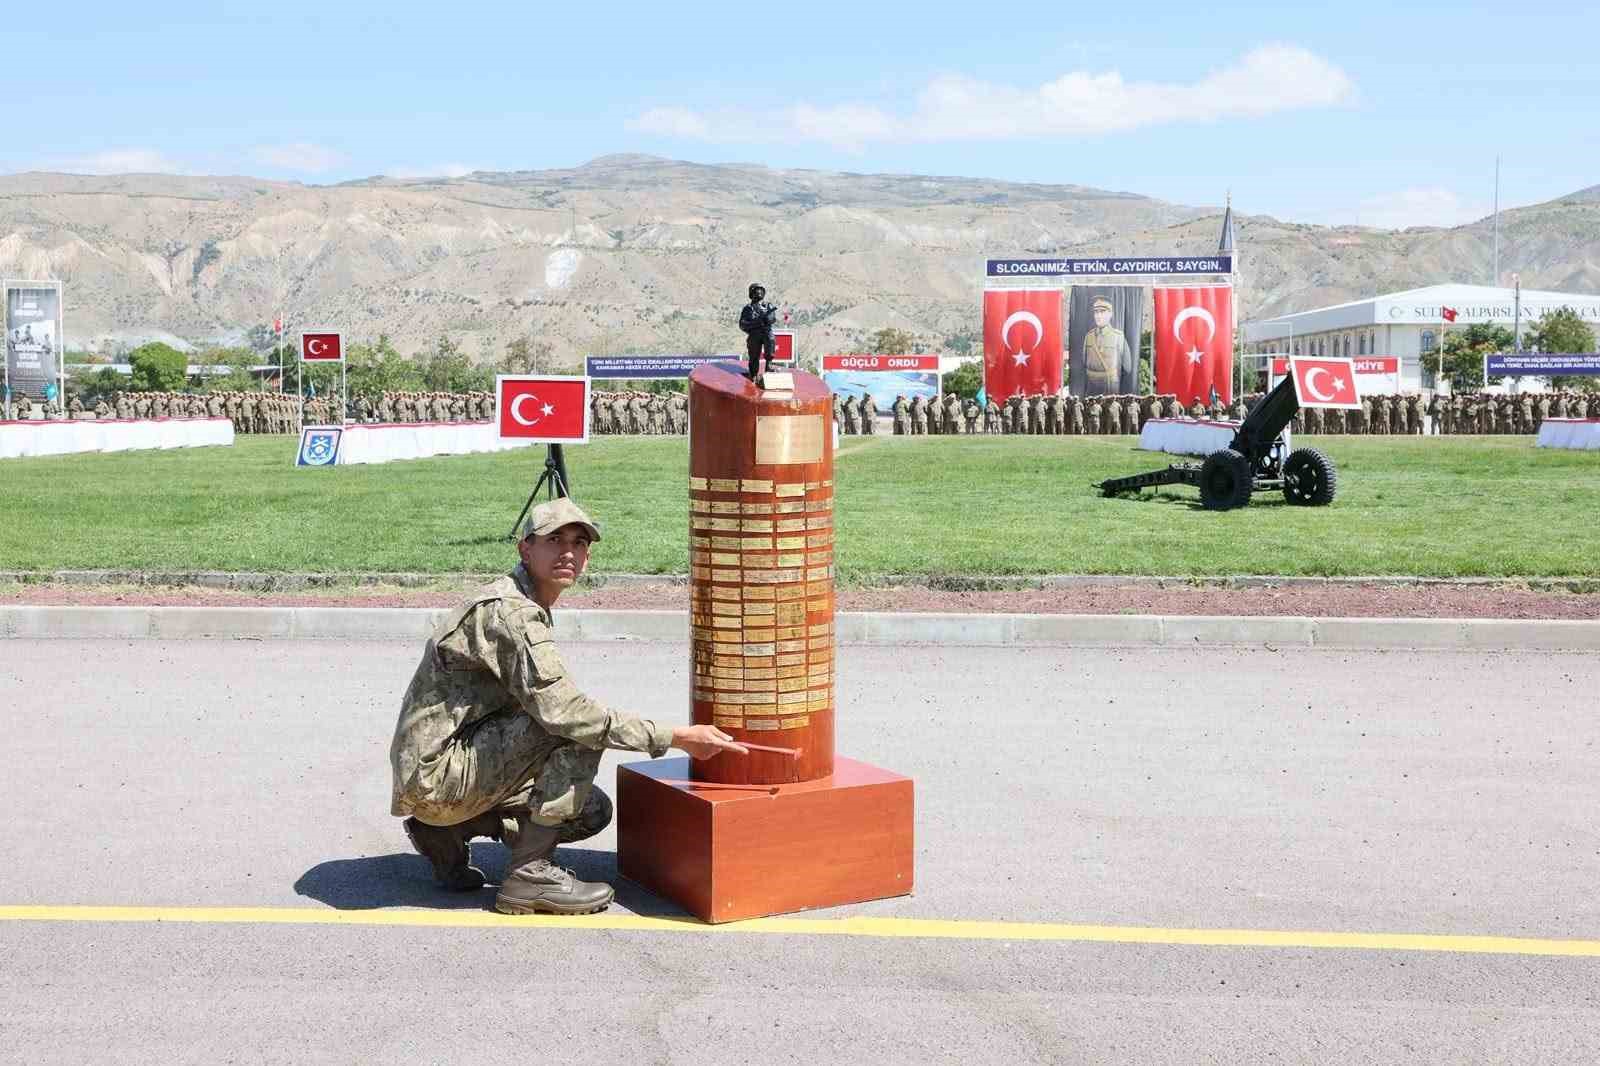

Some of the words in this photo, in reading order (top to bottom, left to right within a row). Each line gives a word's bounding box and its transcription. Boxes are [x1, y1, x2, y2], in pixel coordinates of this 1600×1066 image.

[996, 262, 1070, 273] SLOGANIMIZ:
[1073, 260, 1110, 273] ETKİN,
[1113, 261, 1173, 272] CAYDIRICI,
[1176, 260, 1222, 271] SAYGIN.
[841, 357, 879, 368] GÜÇLÜ
[887, 358, 919, 367] ORDU
